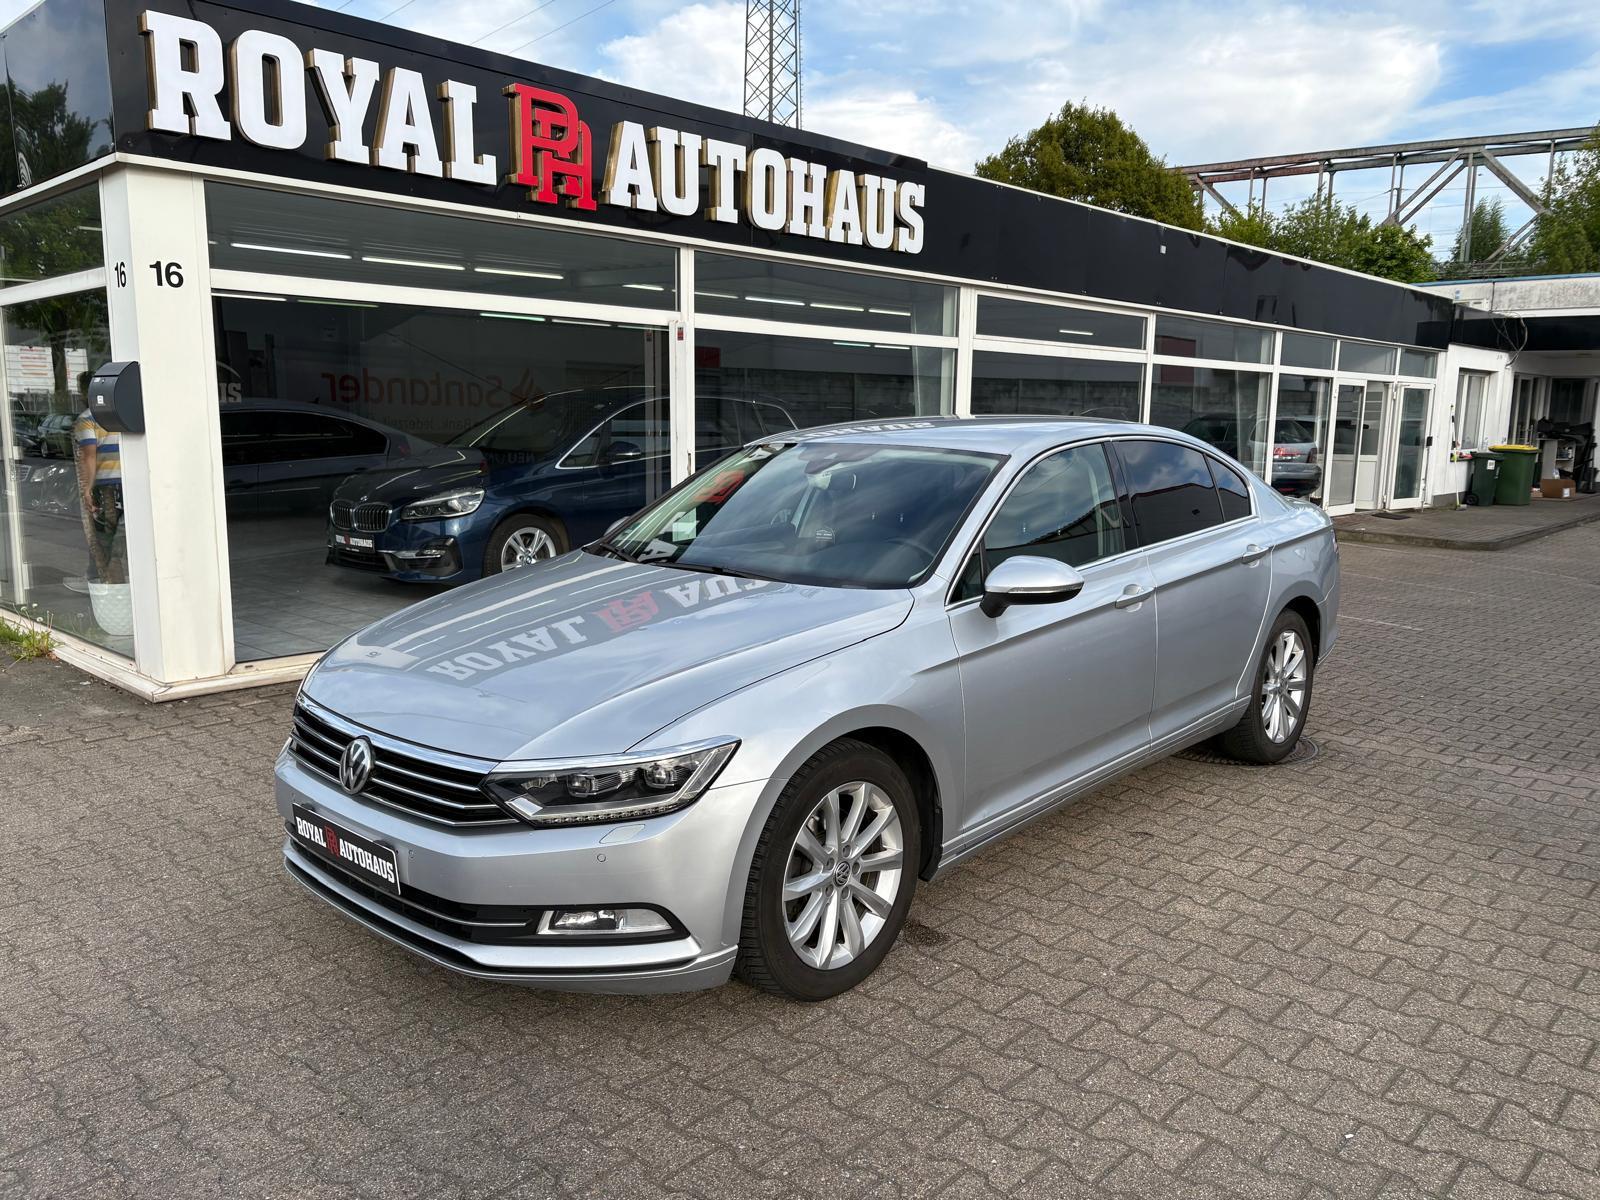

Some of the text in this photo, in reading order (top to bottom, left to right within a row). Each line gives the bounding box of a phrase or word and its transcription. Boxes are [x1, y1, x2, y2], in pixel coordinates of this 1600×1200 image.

[139, 10, 498, 186] ROYAL
[602, 120, 927, 254] AUTOHAUS
[114, 261, 127, 288] 16
[149, 260, 184, 288] 16
[296, 816, 327, 848] ROYAL
[339, 838, 396, 884] AUTOHAUS
